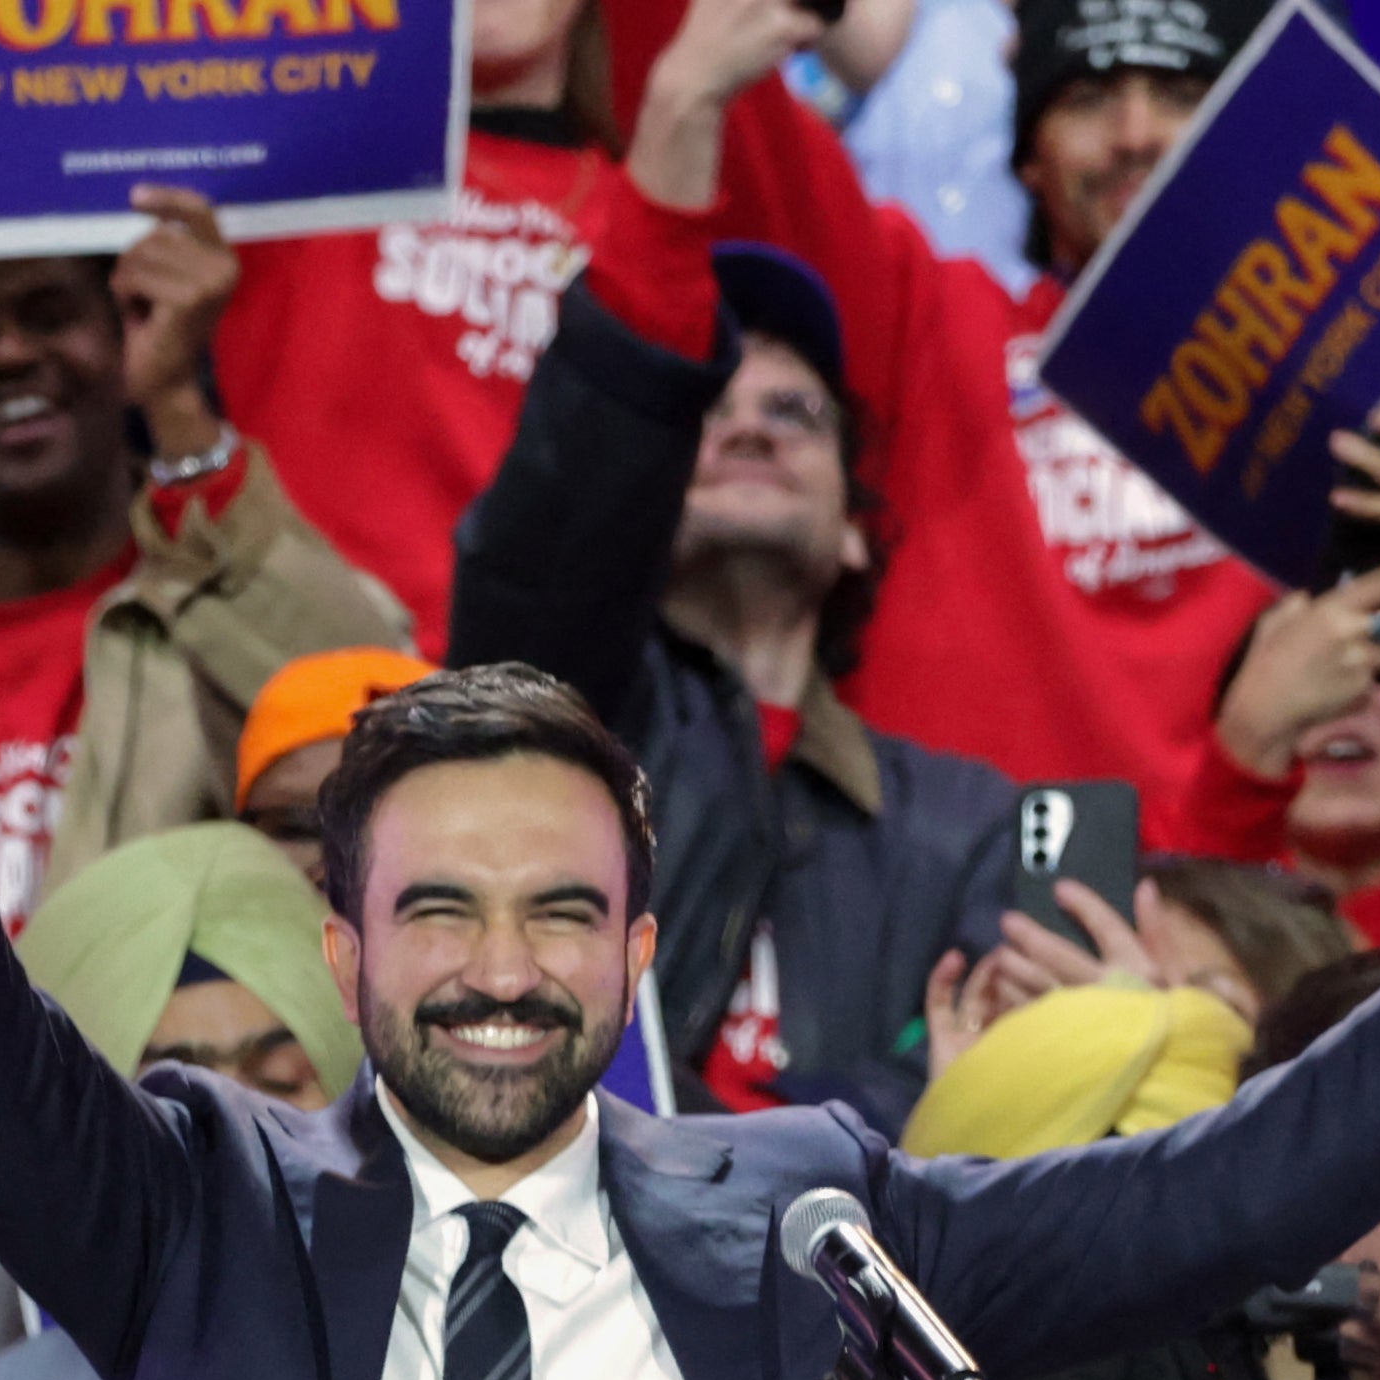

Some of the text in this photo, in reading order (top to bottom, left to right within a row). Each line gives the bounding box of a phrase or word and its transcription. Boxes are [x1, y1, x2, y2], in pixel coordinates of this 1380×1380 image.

[12, 64, 127, 106] NEW
[137, 59, 267, 100] YORK
[272, 50, 377, 92] CITY
